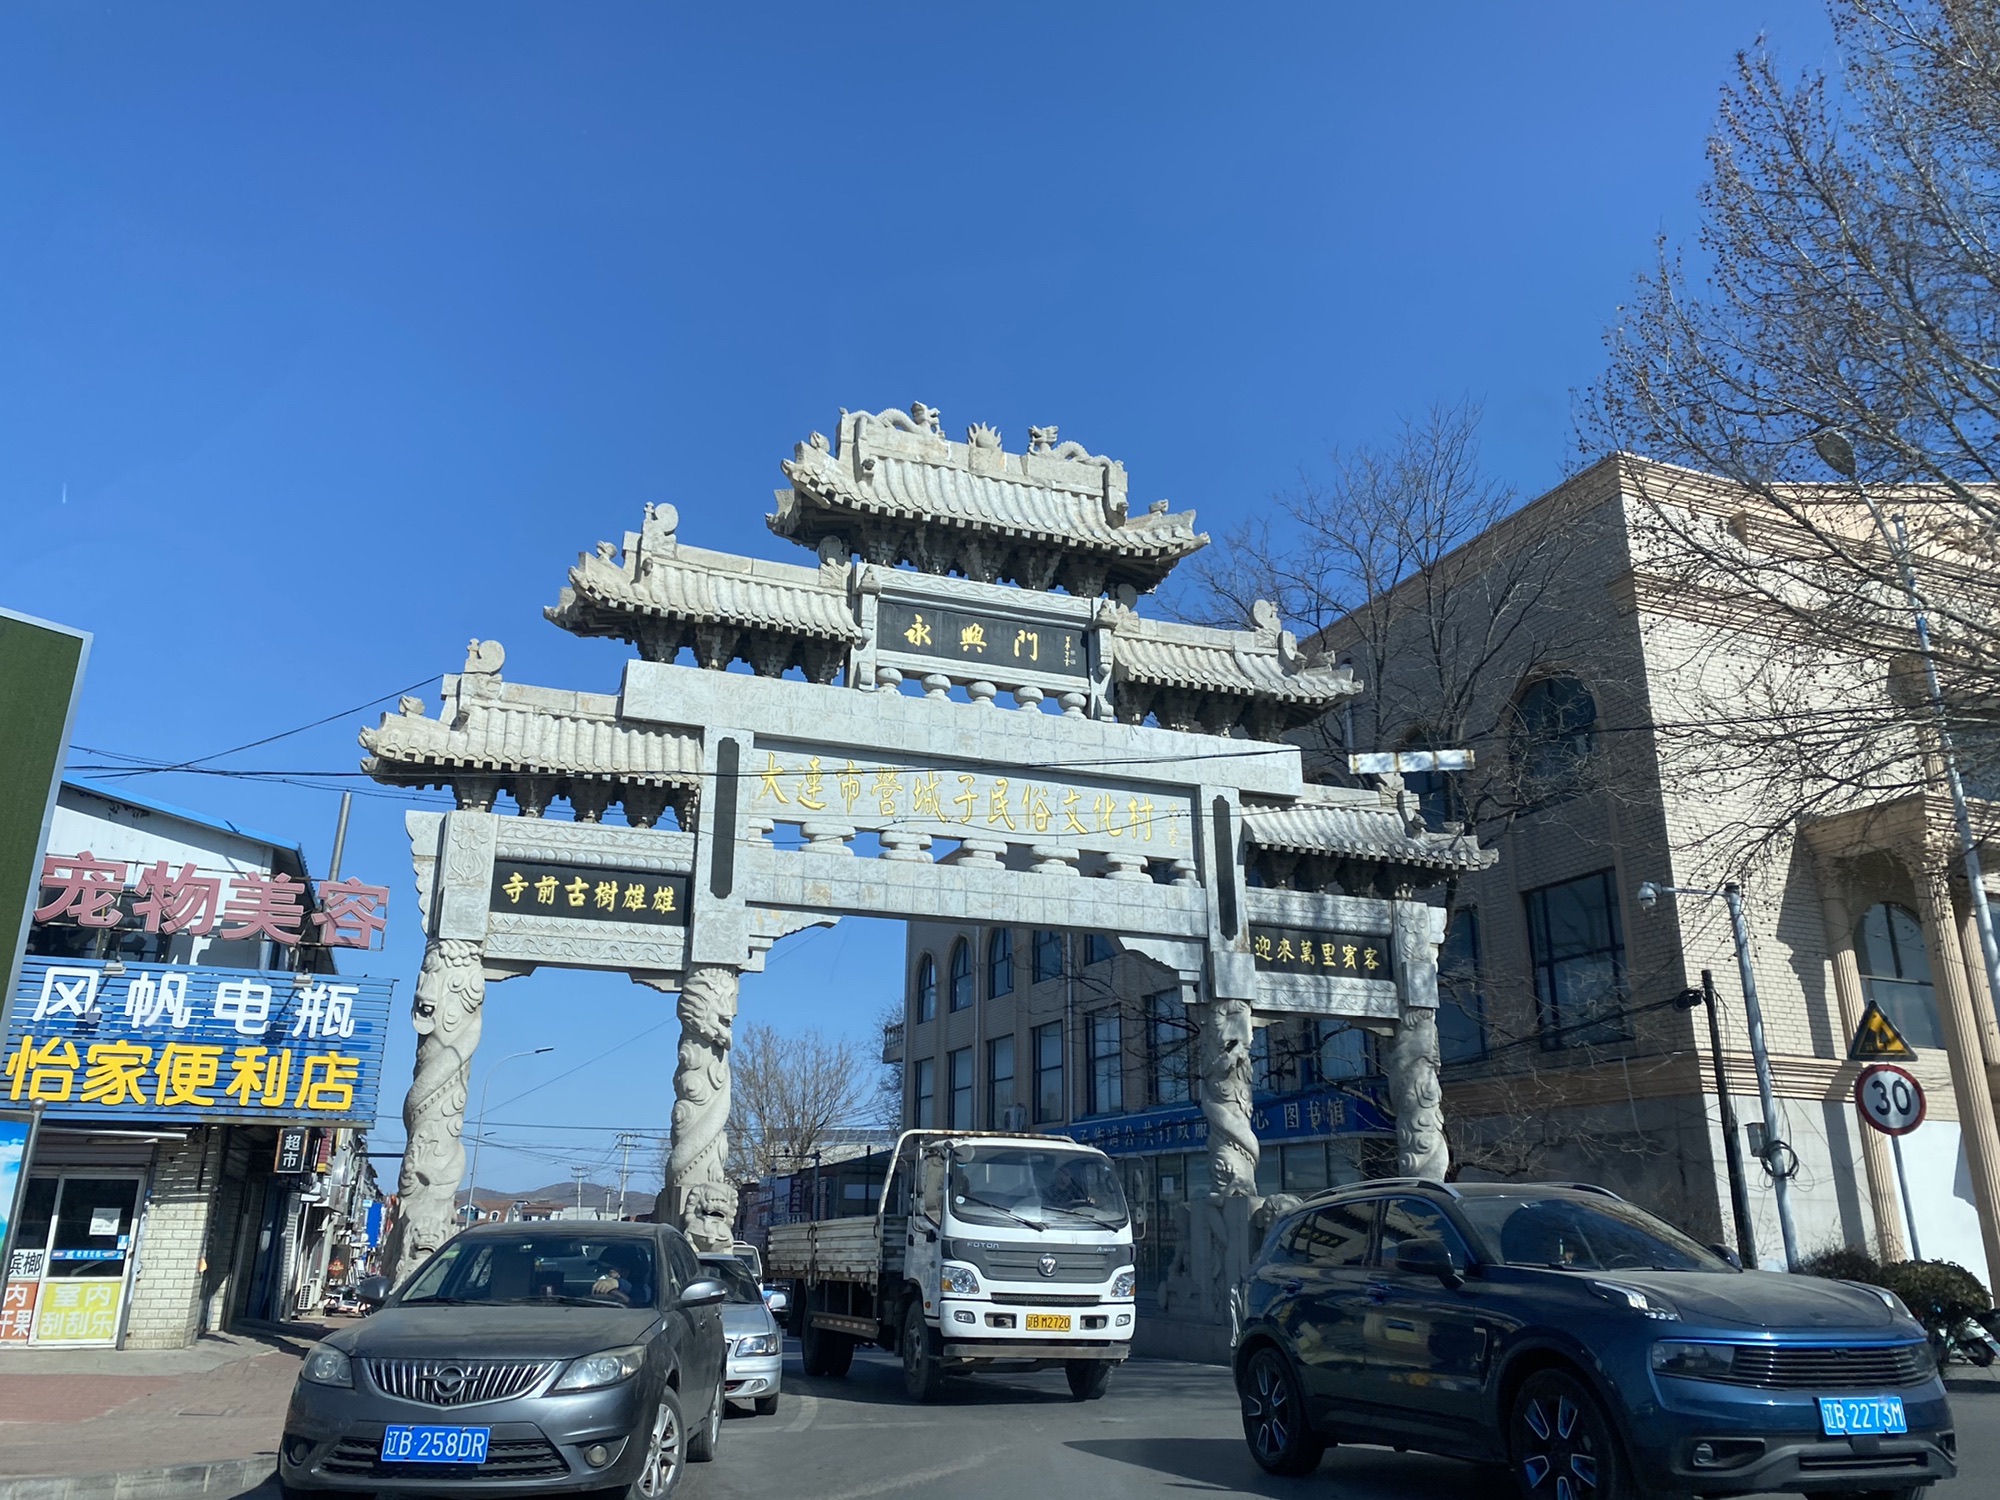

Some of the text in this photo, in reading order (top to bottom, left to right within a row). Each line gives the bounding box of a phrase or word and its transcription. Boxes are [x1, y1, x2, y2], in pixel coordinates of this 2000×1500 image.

[34, 851, 390, 950] 宠物美容
[32, 967, 360, 1039] 风帆电瓶
[5, 1035, 360, 1111] 怡家便利店
[1872, 1080, 1912, 1116] 30
[283, 1134, 301, 1168] 超市
[52, 1285, 112, 1308] 室内
[40, 1310, 113, 1337] 刮刮乐
